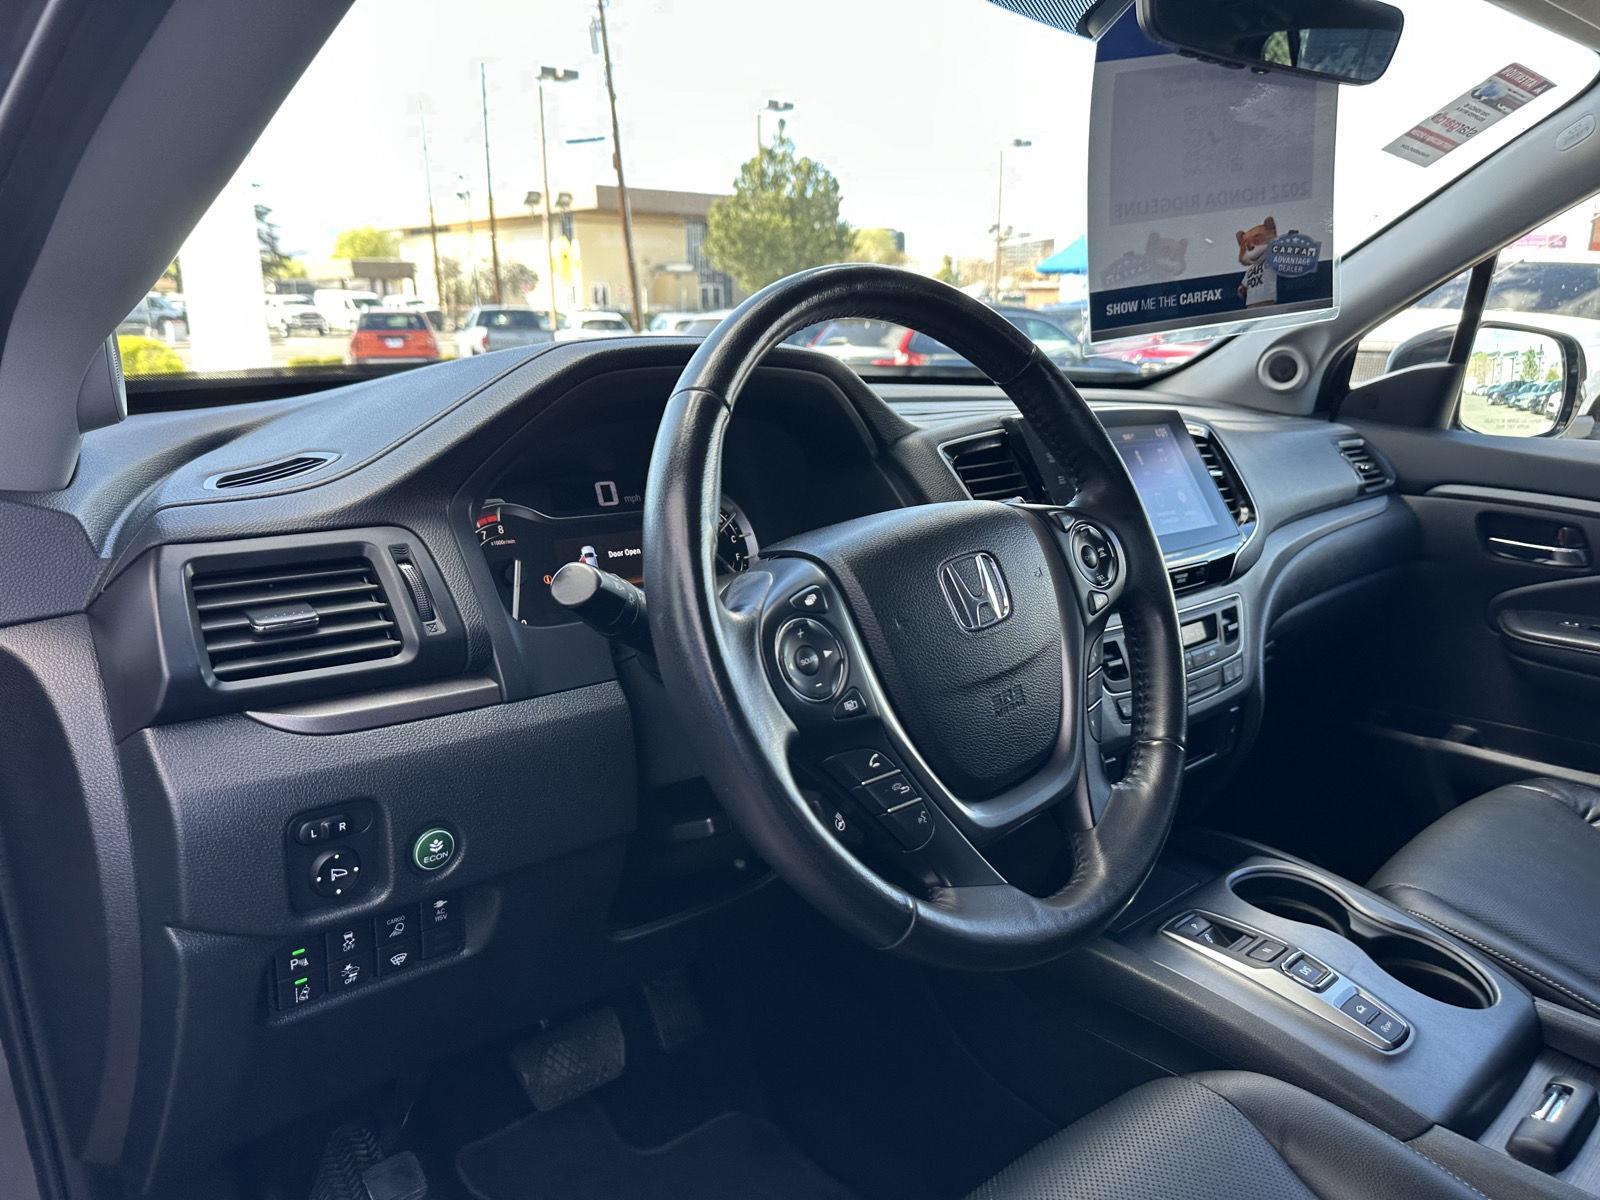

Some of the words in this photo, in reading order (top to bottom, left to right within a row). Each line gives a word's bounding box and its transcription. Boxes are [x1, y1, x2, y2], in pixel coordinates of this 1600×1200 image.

[1247, 275, 1264, 288] FOX
[1106, 300, 1139, 316] SHOW
[1141, 297, 1157, 310] ME
[1159, 294, 1178, 308] THE
[1180, 288, 1222, 306] CARFAX
[594, 481, 619, 506] 0
[623, 494, 642, 504] mph
[497, 525, 505, 535] 8
[480, 531, 488, 541] 7
[730, 534, 737, 544] C
[608, 550, 624, 559] Door
[624, 547, 642, 557] Open
[735, 552, 741, 561] F
[339, 822, 347, 831] R
[311, 829, 317, 838] L
[423, 851, 449, 864] ECON
[436, 908, 446, 916] AC
[386, 915, 406, 925] CARGO
[344, 975, 358, 985] OFF
